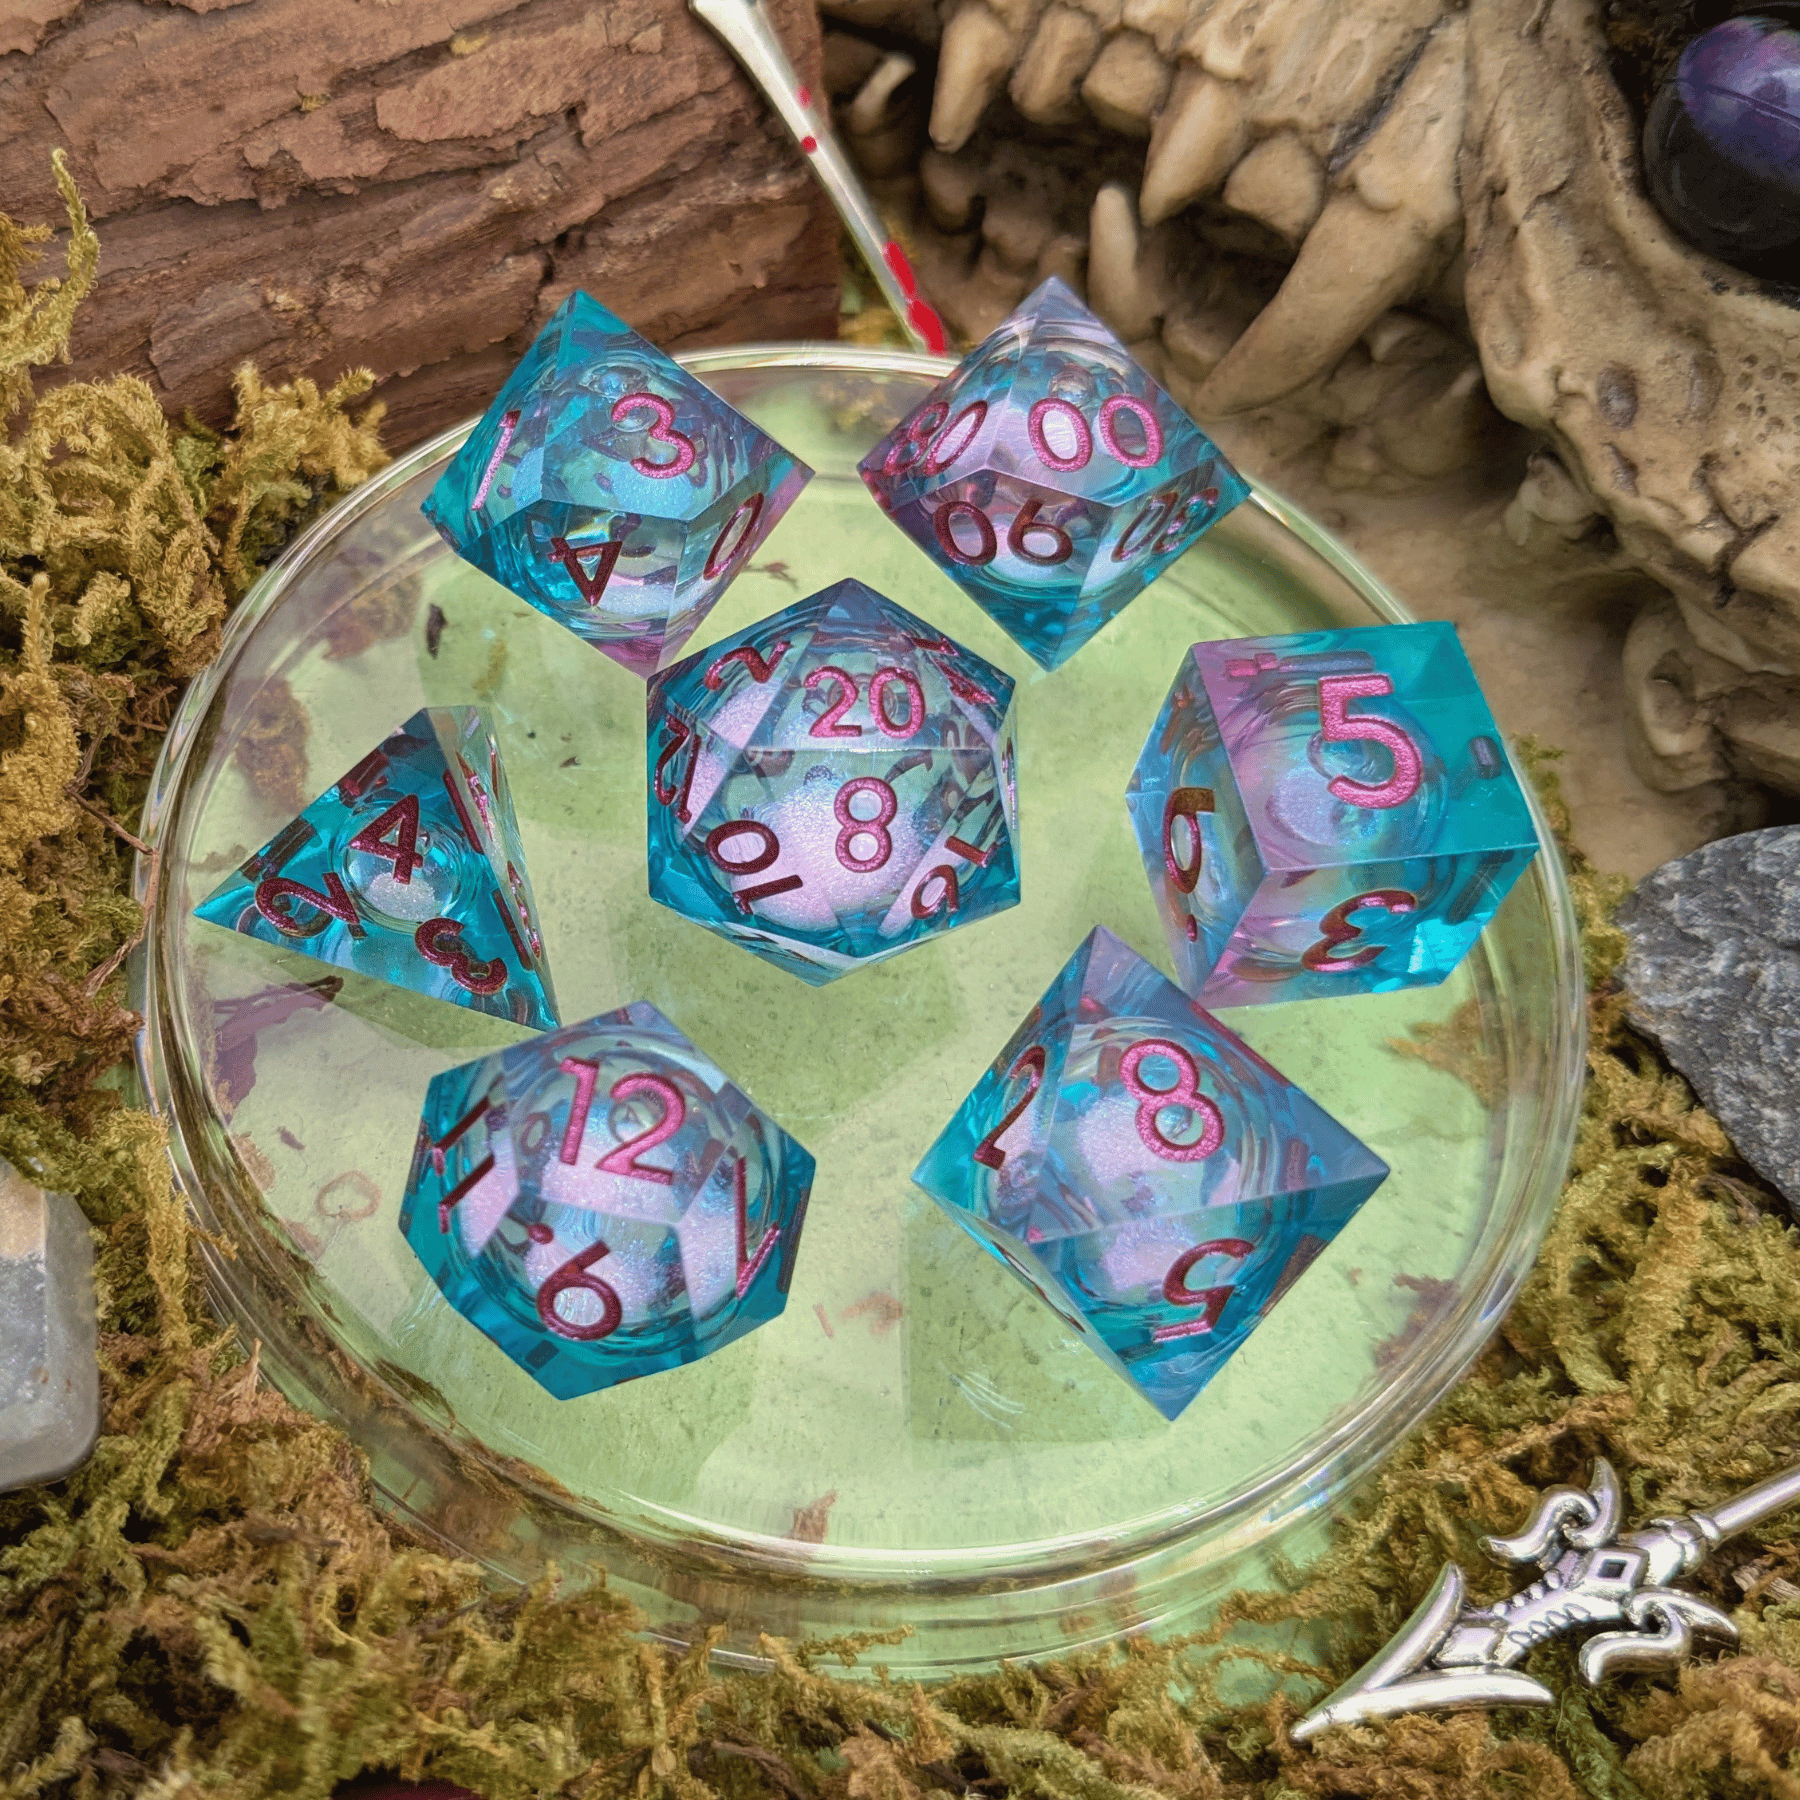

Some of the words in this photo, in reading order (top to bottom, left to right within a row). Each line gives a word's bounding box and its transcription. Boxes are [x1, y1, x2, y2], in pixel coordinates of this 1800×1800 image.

[472, 409, 522, 511] 1
[610, 391, 696, 480] 3
[1027, 392, 1165, 473] 00
[546, 536, 623, 606] 4
[703, 492, 765, 580] 0
[703, 640, 792, 691] 2
[804, 665, 926, 740] 20
[1317, 673, 1424, 810] 5
[349, 793, 424, 886] 4
[833, 776, 898, 874] 8
[413, 916, 508, 995] 3
[1302, 888, 1418, 973] 3
[558, 1055, 688, 1187] 12
[972, 1045, 1046, 1171] 2
[1118, 1038, 1225, 1163] 8
[1152, 1237, 1255, 1343] 5
